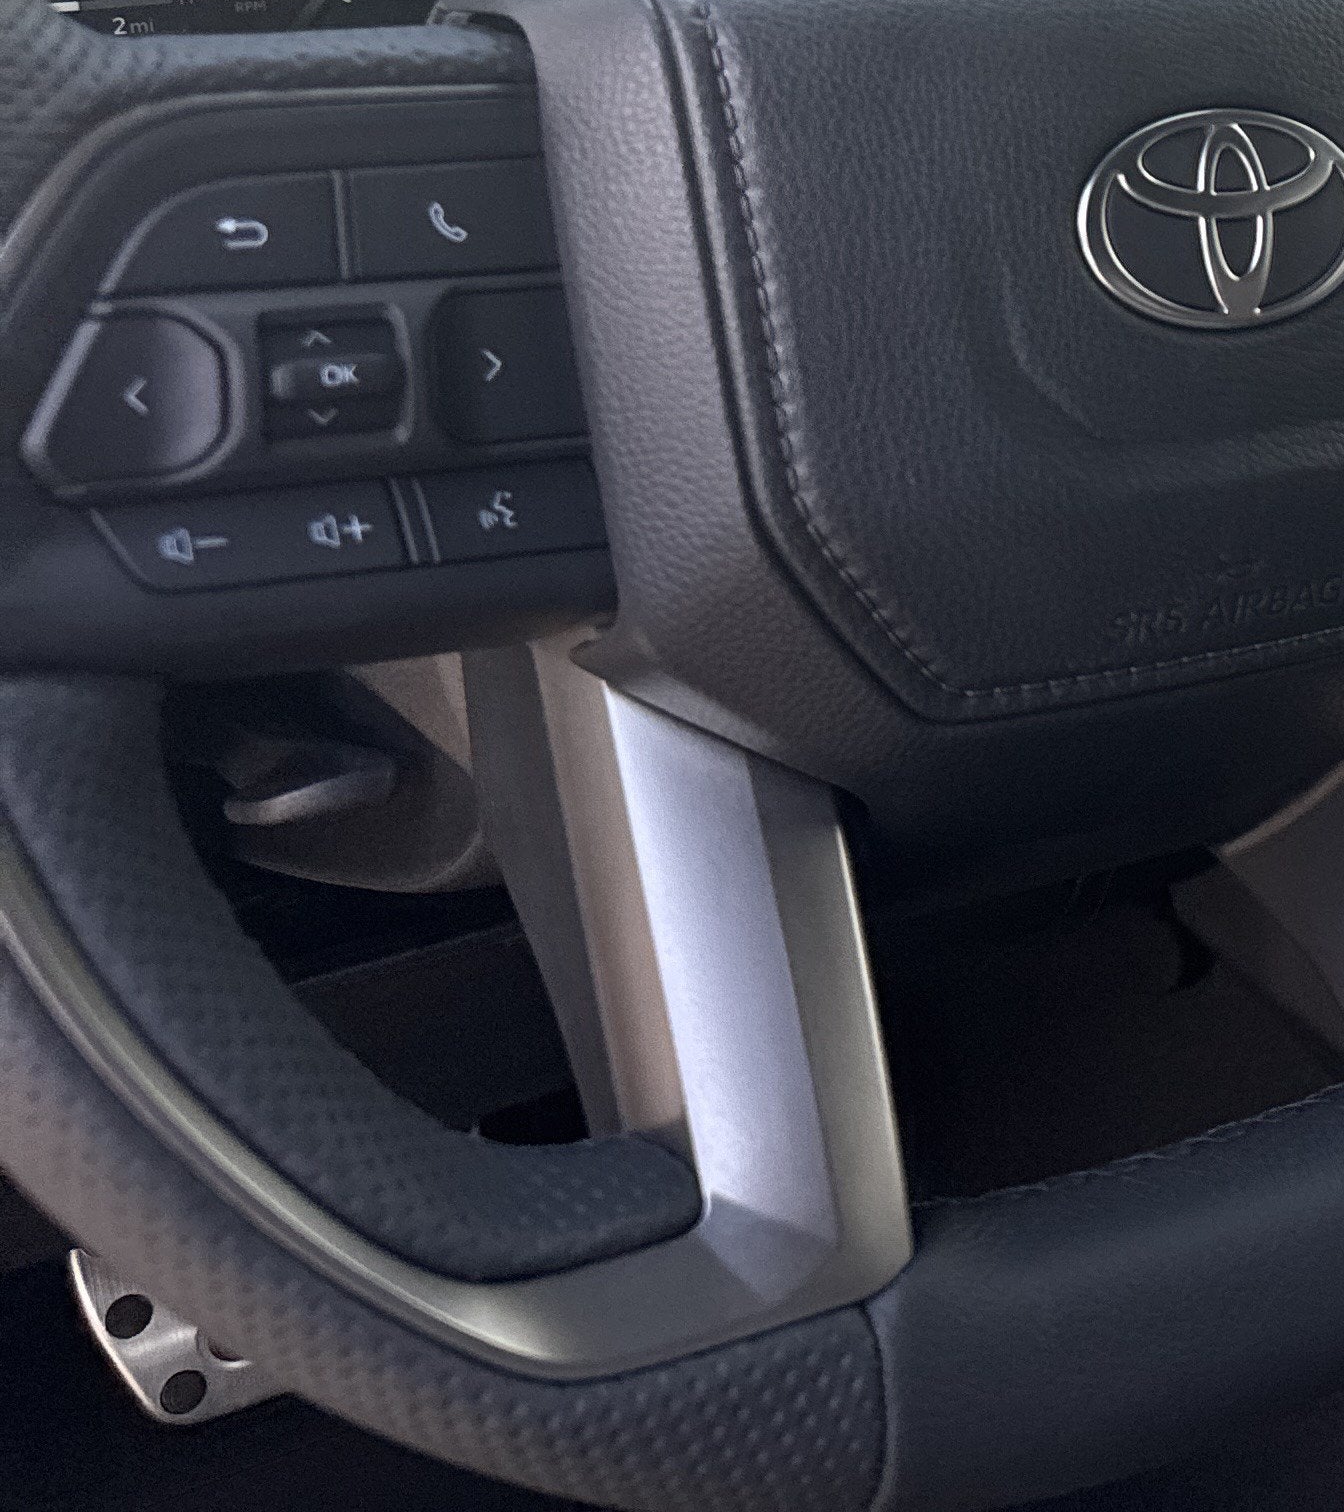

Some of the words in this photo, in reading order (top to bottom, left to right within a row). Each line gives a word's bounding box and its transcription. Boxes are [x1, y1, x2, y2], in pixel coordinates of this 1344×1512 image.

[112, 17, 127, 35] 2
[130, 18, 155, 34] mi
[319, 362, 359, 387] OK
